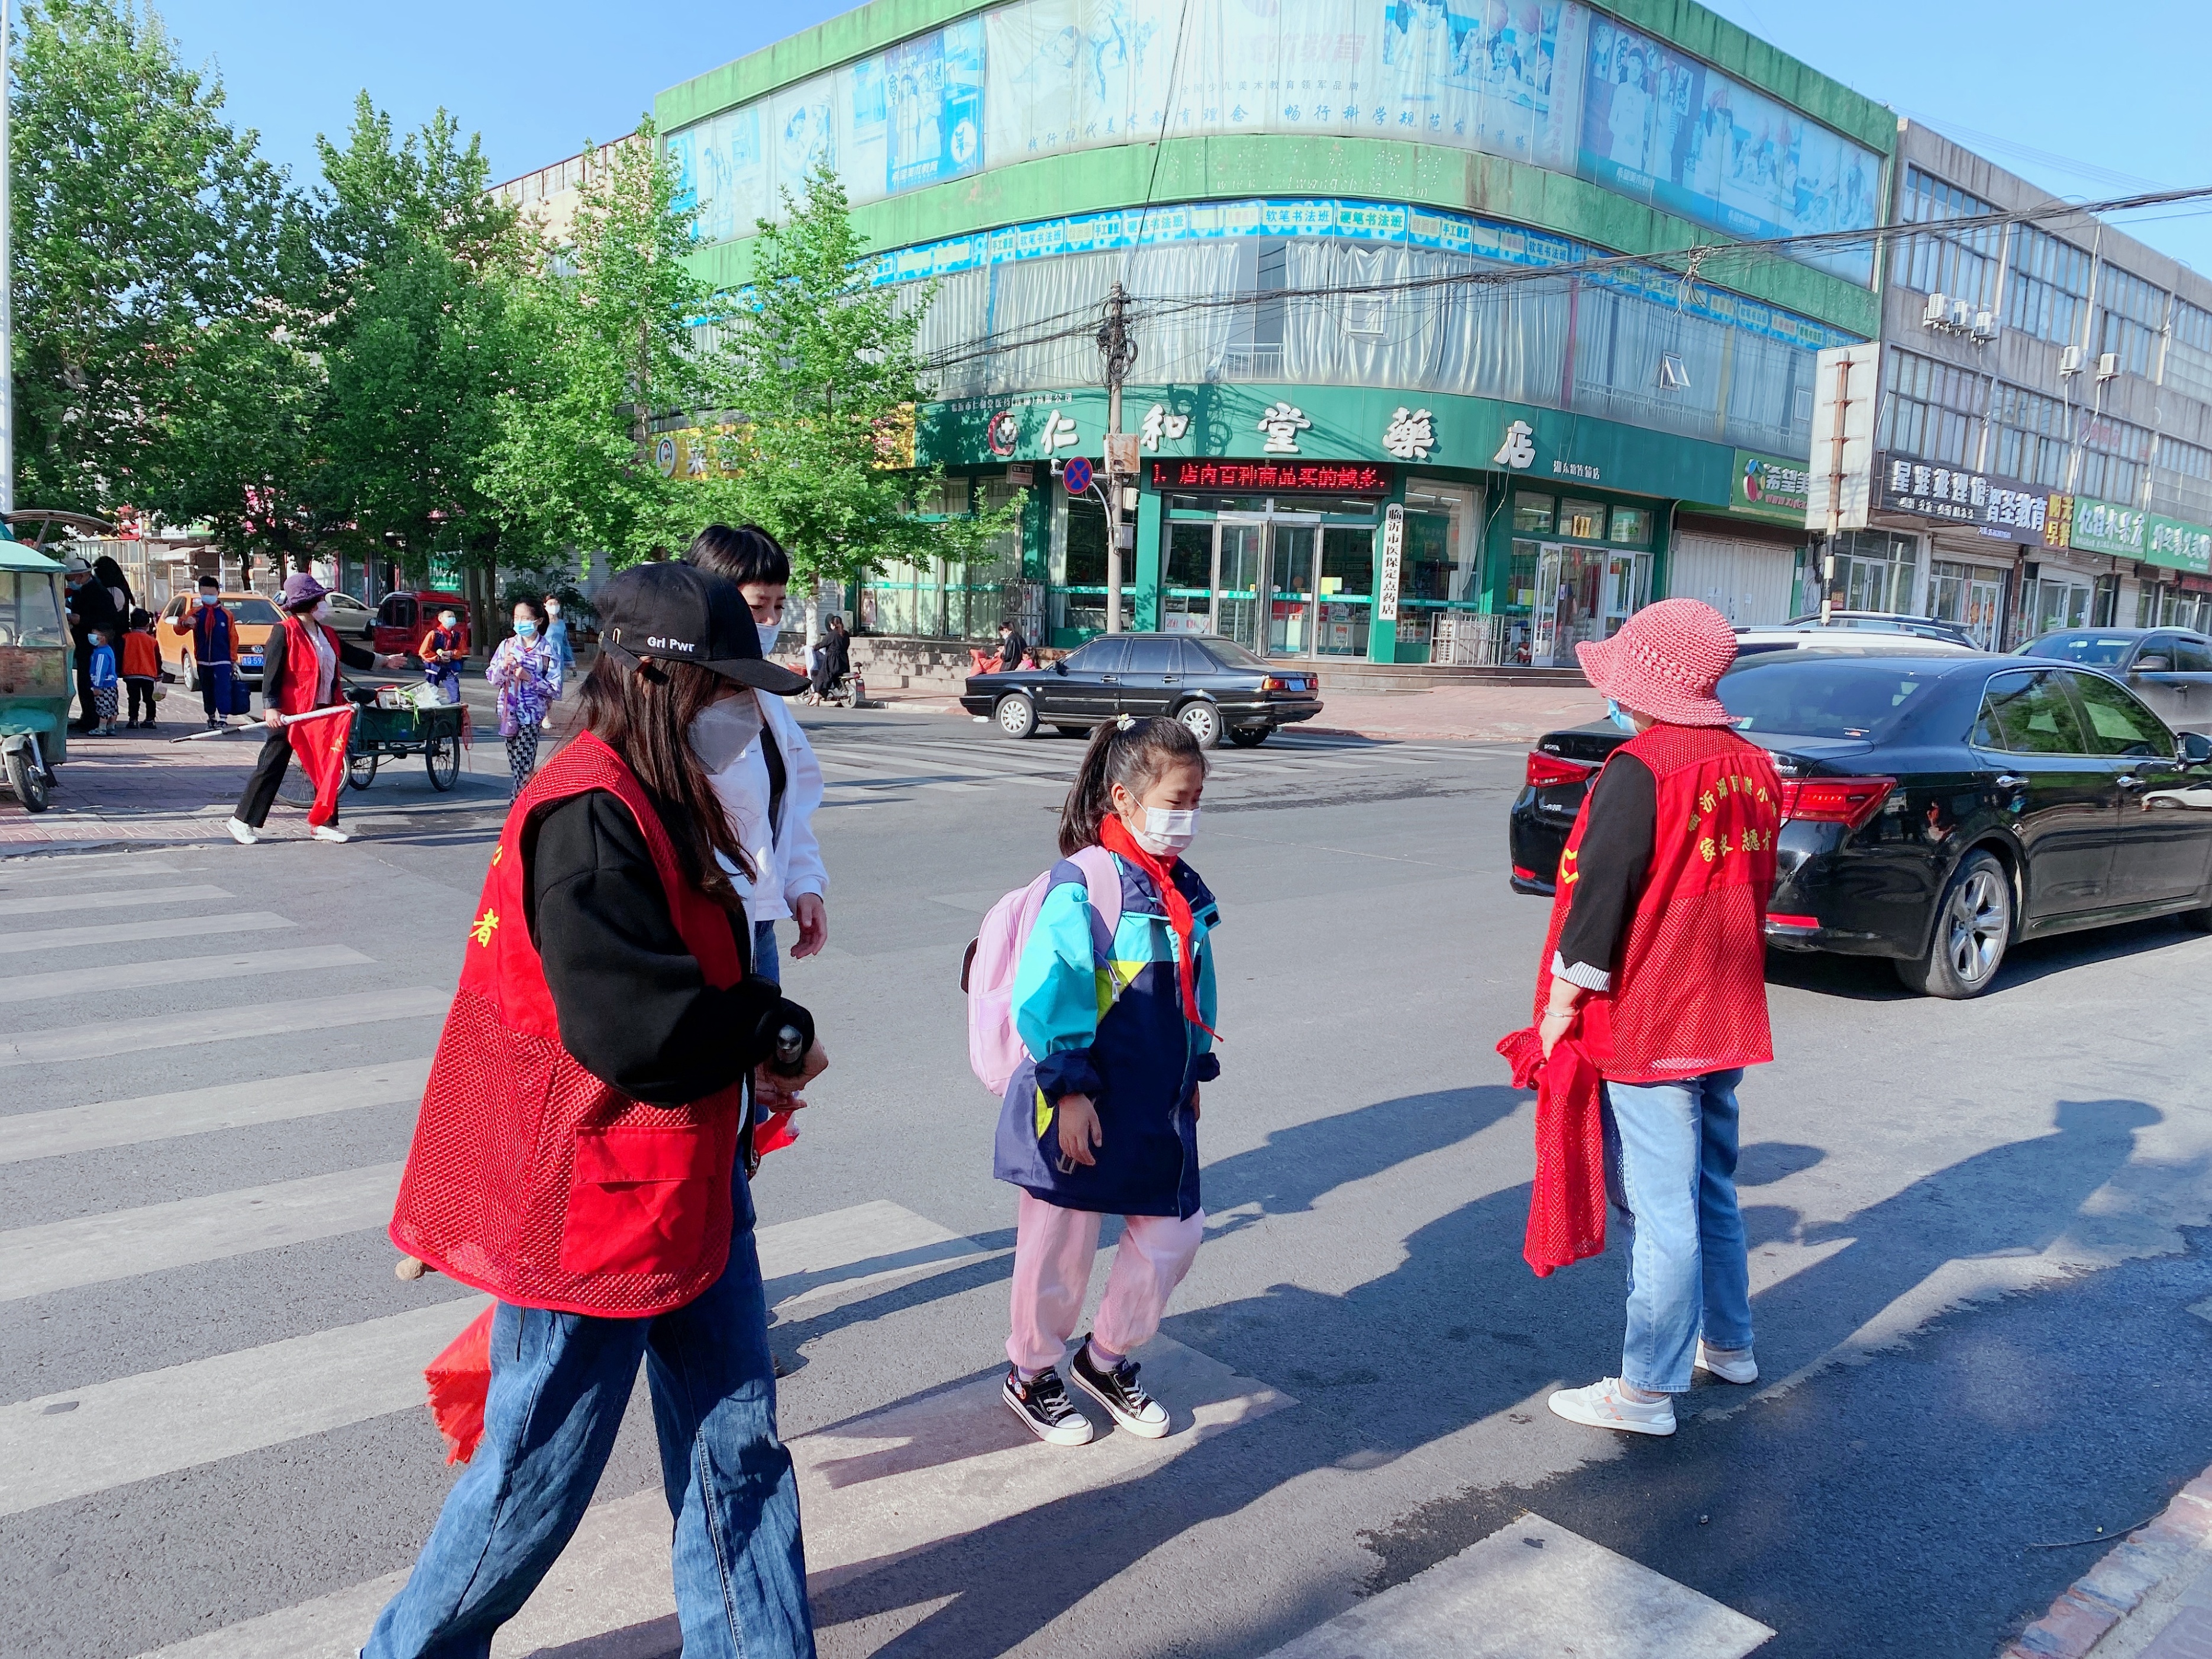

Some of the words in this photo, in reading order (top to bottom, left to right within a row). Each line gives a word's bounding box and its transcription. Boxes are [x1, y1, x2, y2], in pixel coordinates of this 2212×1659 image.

[1266, 209, 1331, 223] 软笔书法班
[1340, 211, 1403, 228] 硬笔书法班
[1020, 229, 1061, 247] 软笔书法班
[1529, 240, 1568, 262] 软笔书法班
[1381, 509, 1402, 615] 临沂市医保定点药店
[647, 636, 666, 648] Grl
[669, 638, 695, 652] Pwr
[469, 908, 499, 948] 者
